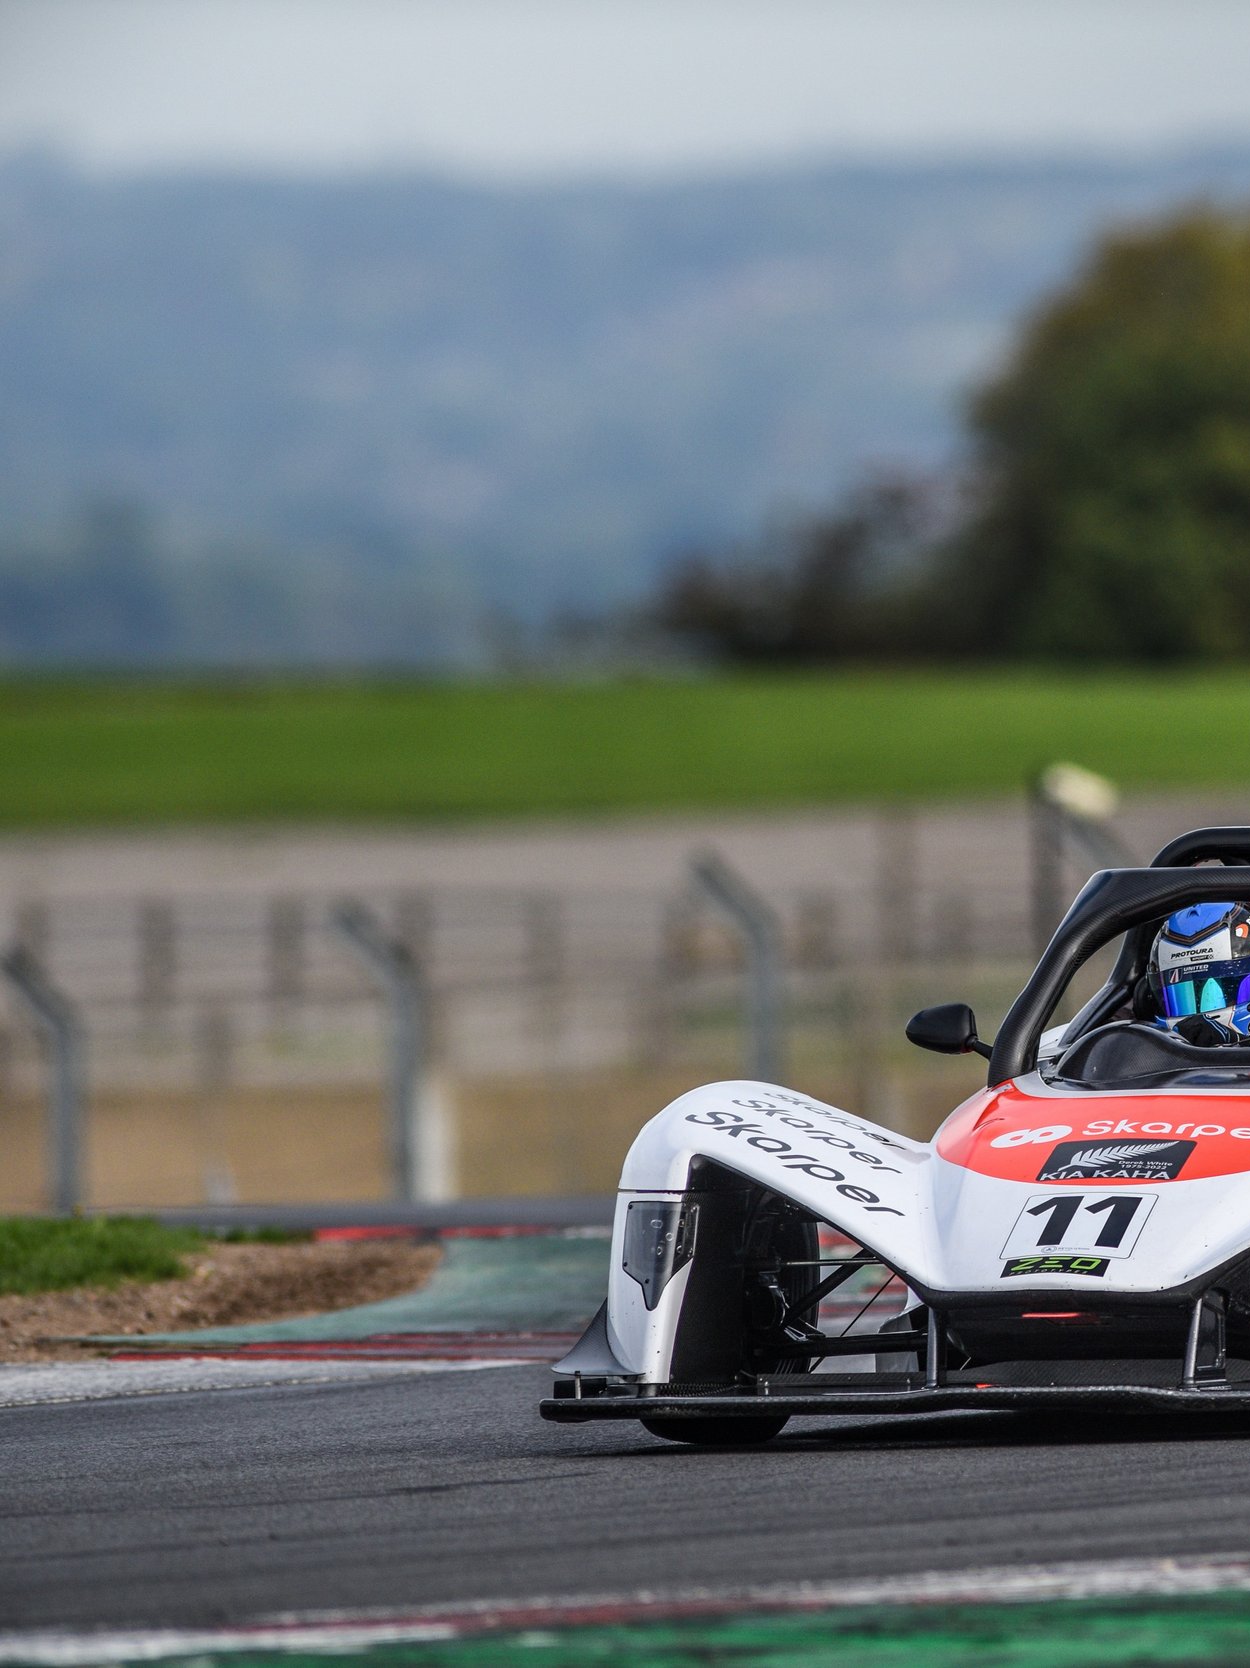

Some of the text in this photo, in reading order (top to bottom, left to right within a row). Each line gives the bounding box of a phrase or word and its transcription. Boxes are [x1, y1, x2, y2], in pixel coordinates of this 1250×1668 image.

[1171, 948, 1213, 959] PROTOURA
[1184, 964, 1209, 972] UNITED
[732, 1099, 903, 1174] Skarper
[763, 1092, 907, 1151] Skarper
[685, 1111, 906, 1217] Skarper
[1040, 1170, 1171, 1181] KIA KAHA
[1026, 1195, 1143, 1249] 11
